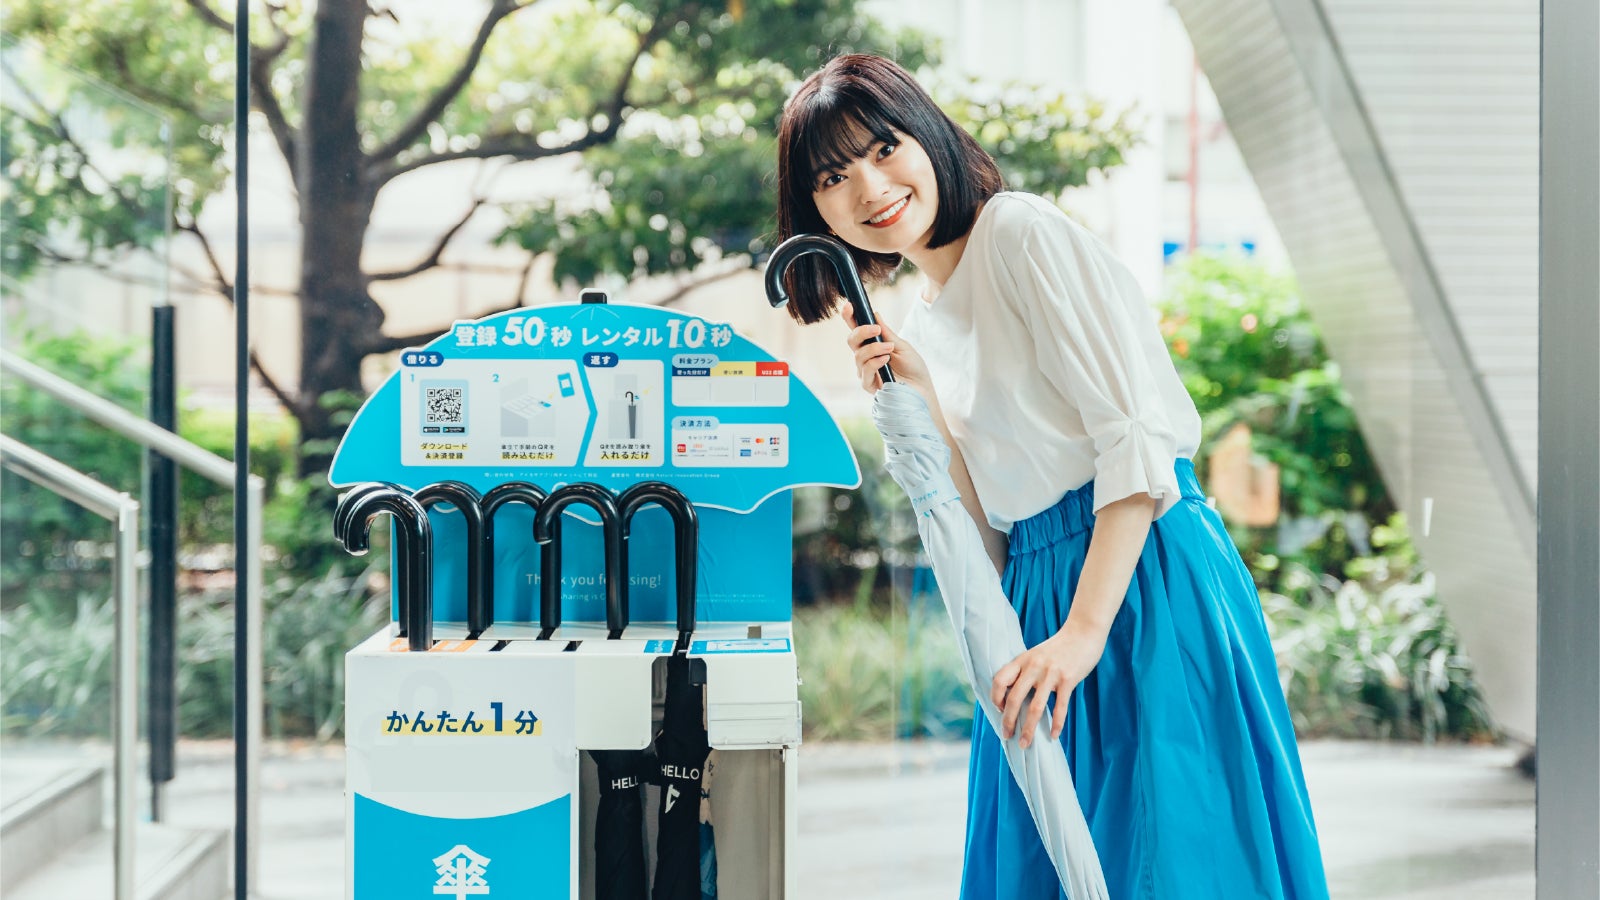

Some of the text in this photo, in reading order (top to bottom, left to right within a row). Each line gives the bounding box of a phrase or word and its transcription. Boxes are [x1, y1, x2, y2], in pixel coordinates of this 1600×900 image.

[406, 354, 439, 365] 借りる
[590, 355, 611, 365] 返す
[679, 357, 713, 365] 料金プラン
[410, 373, 415, 383] 1
[492, 373, 499, 383] 2
[680, 420, 711, 428] 決済方法
[421, 442, 467, 450] ダウンロード
[502, 451, 554, 460] 読み込むだけ
[601, 451, 650, 460] 入れるだけ
[525, 573, 566, 585] Thk
[570, 576, 594, 588] you
[629, 574, 661, 588] sing!
[386, 702, 538, 735] かんたん1分
[661, 764, 700, 780] HELLO
